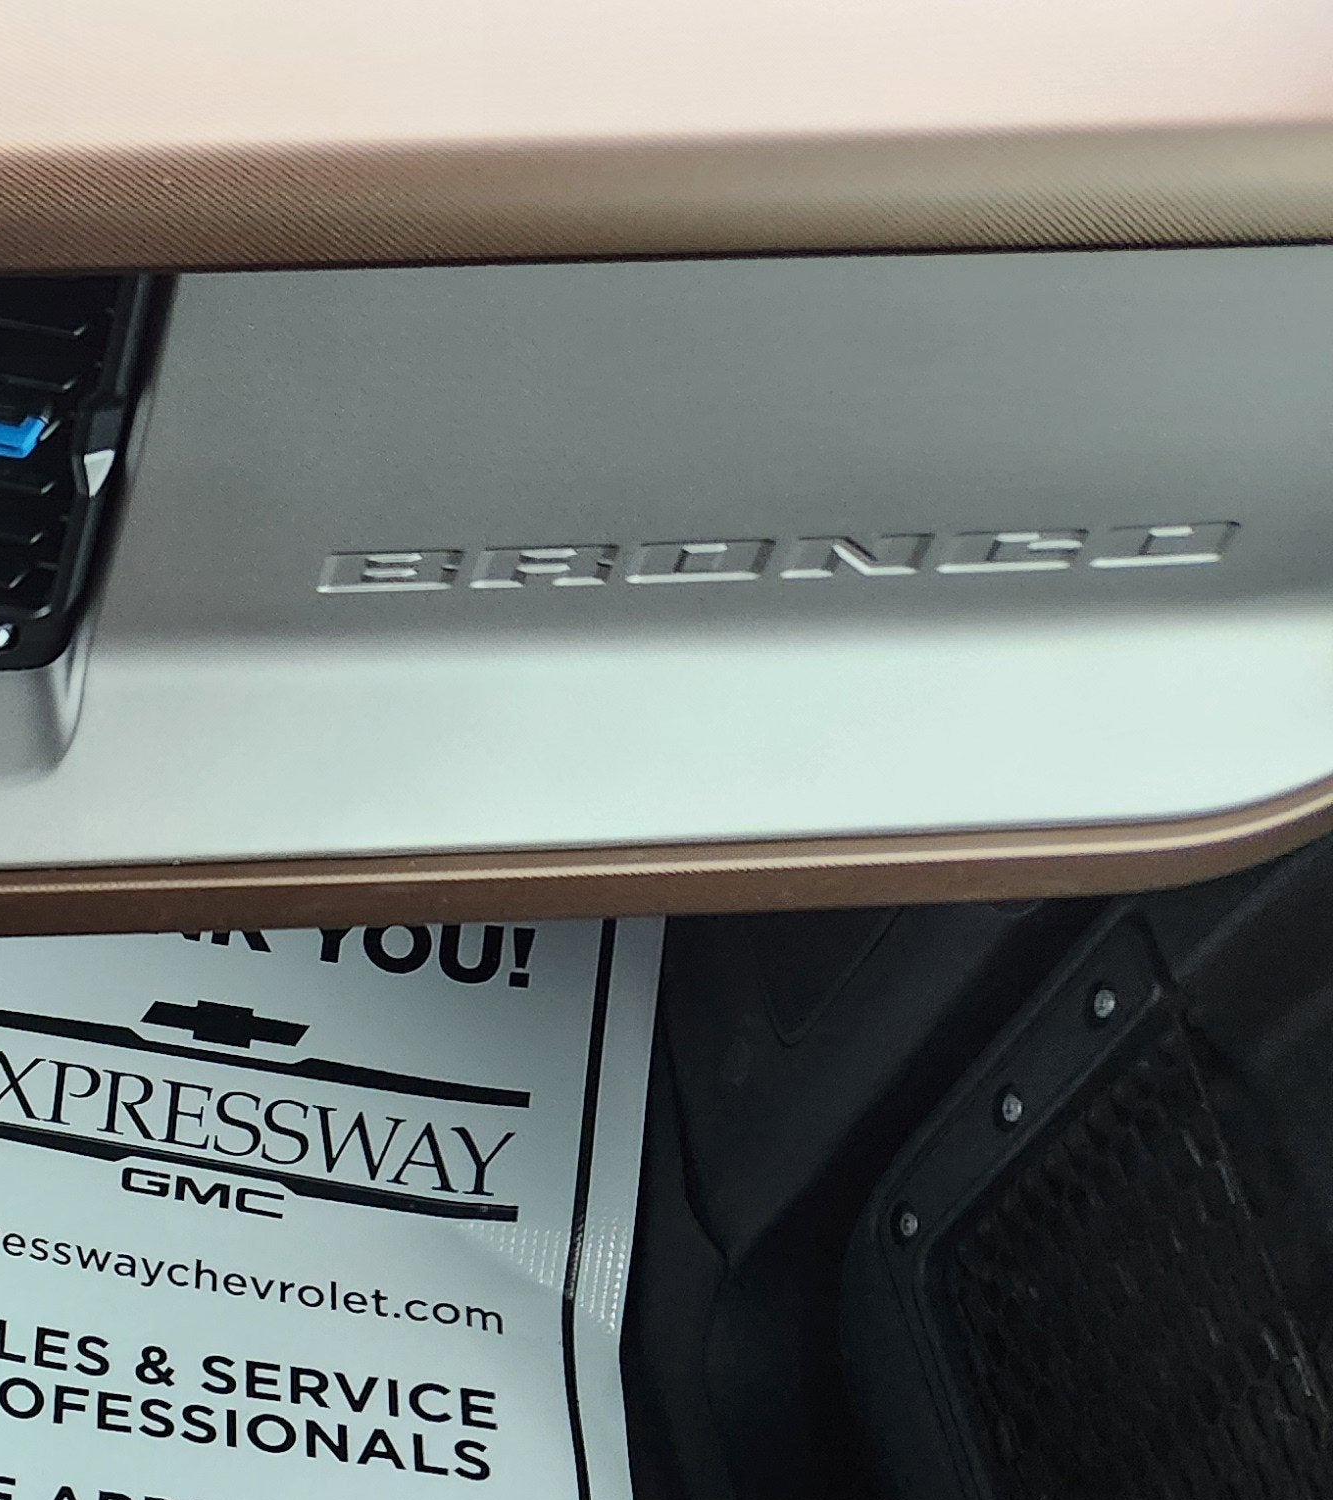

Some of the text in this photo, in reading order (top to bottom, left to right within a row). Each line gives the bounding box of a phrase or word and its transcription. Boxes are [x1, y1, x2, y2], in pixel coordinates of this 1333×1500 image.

[317, 520, 1241, 593] BRONCO
[120, 1165, 285, 1220] GMC
[134, 1345, 176, 1388] &
[200, 1353, 500, 1432] SERVICE
